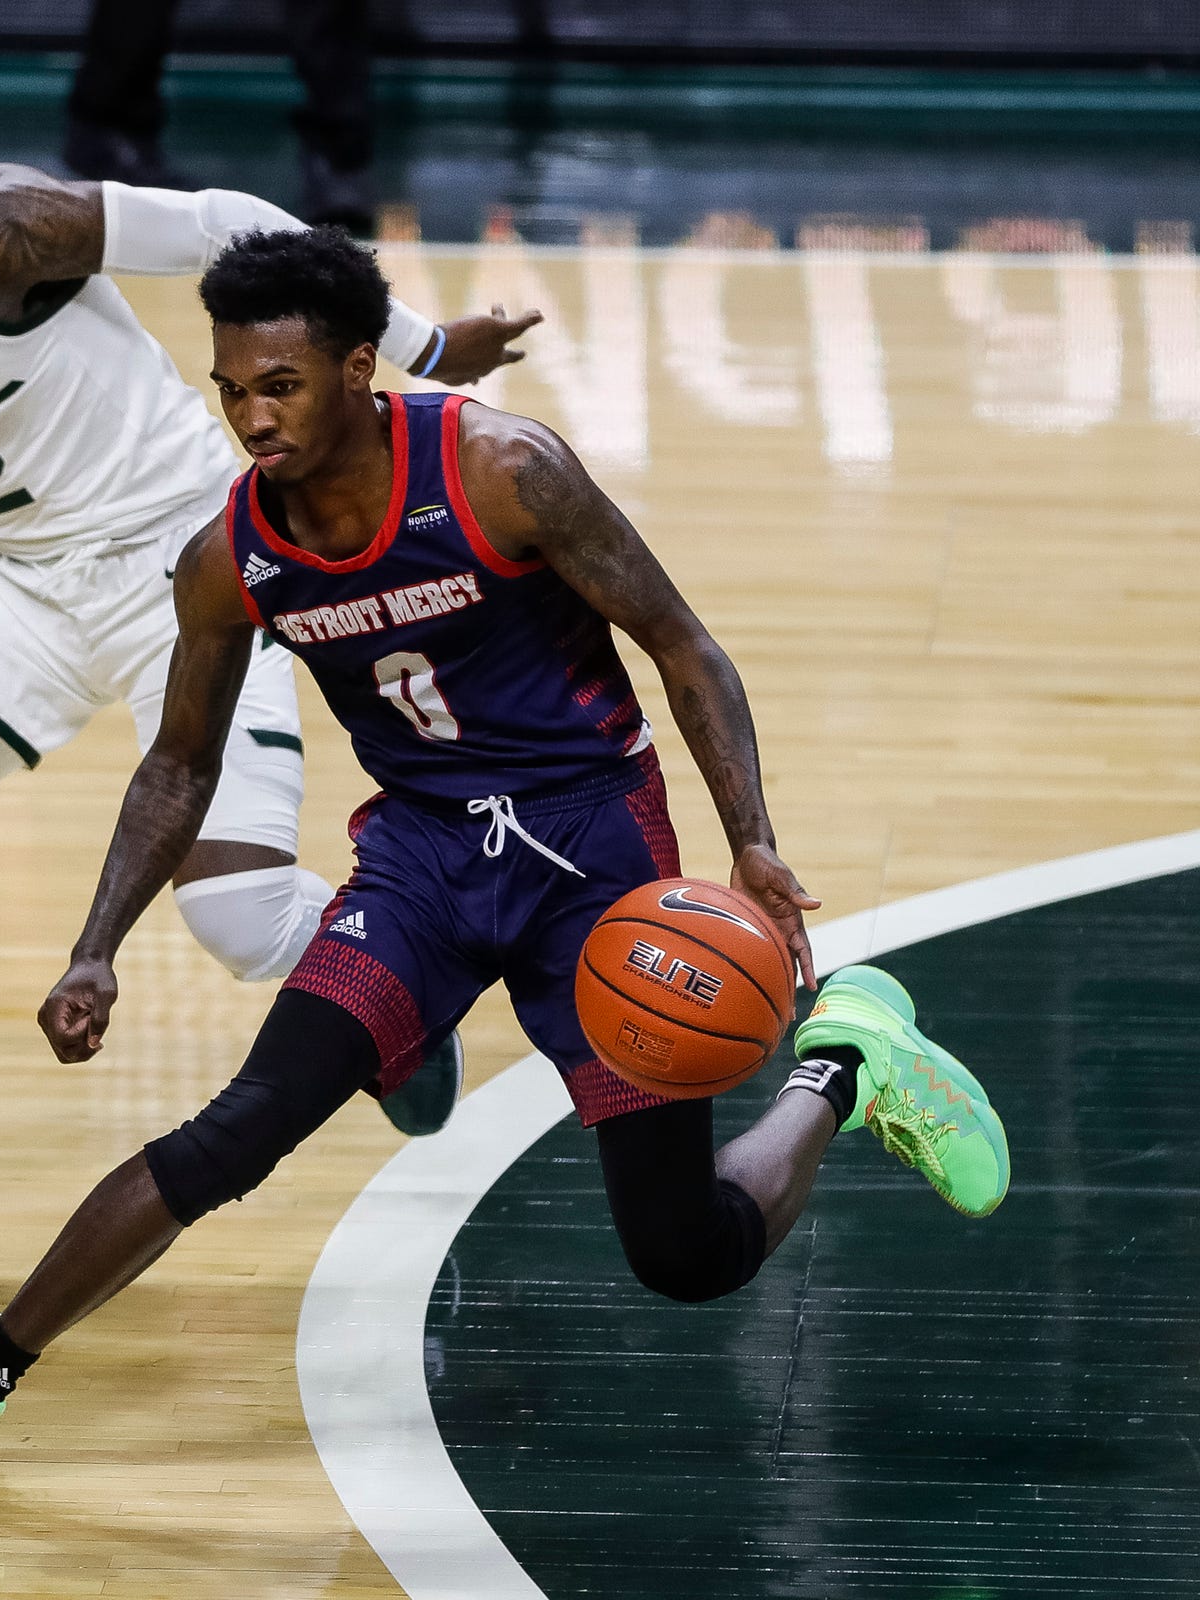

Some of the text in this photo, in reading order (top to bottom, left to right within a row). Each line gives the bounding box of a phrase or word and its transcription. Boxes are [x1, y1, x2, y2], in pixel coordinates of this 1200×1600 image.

[407, 508, 448, 526] HORIZON
[243, 565, 281, 588] adidas
[272, 572, 484, 643] DETROIT MERCY
[373, 650, 461, 742] 0
[329, 923, 368, 940] adidas
[622, 964, 712, 1010] CHAMPIONSHIP
[626, 939, 724, 1004] ELITE
